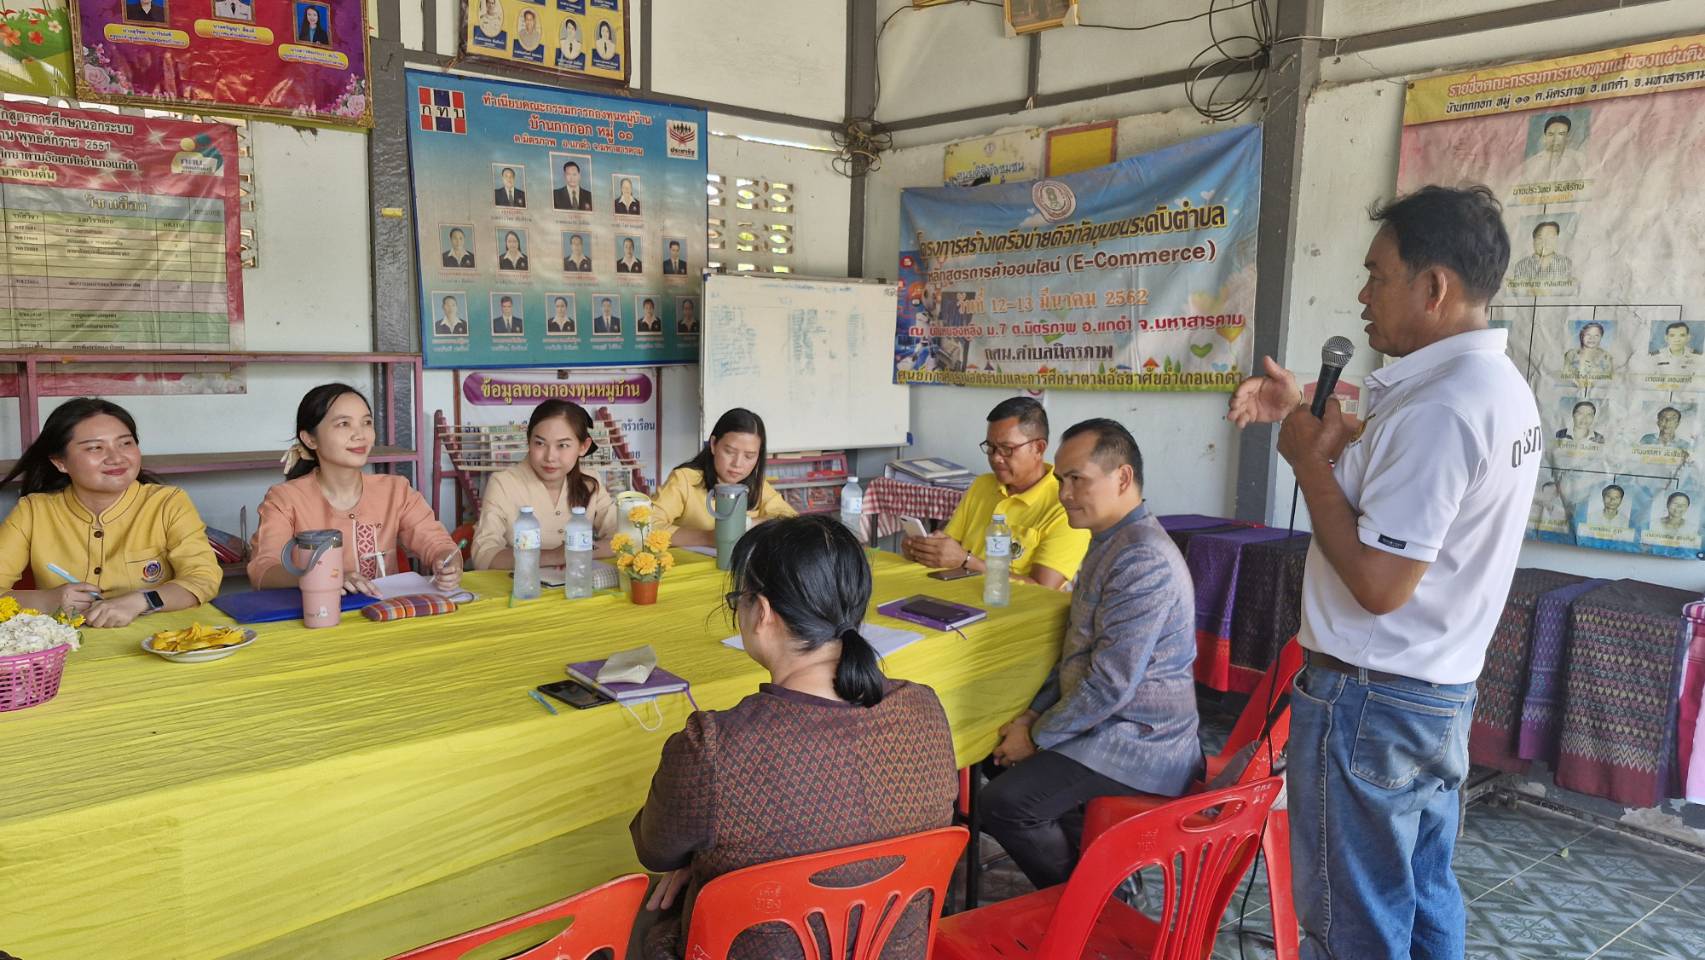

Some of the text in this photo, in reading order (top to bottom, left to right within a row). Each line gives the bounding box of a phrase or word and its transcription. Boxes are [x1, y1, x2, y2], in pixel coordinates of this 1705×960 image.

[18, 129, 79, 148] พุทธศักราช
[85, 140, 111, 152] 2551
[928, 239, 1216, 285] หลักสูตรการค้าออนไลน์ (E-Commerce)
[1039, 287, 1097, 311] มีนาคม
[1104, 288, 1149, 307] 2562
[1012, 318, 1076, 336] ต.มิตรภาพ
[1083, 315, 1132, 334] อ.แกดำ
[1138, 314, 1243, 332] จ.มหาสารคาม
[481, 377, 641, 404] ข้อมูลของกองทุนหมู่บ้าน
